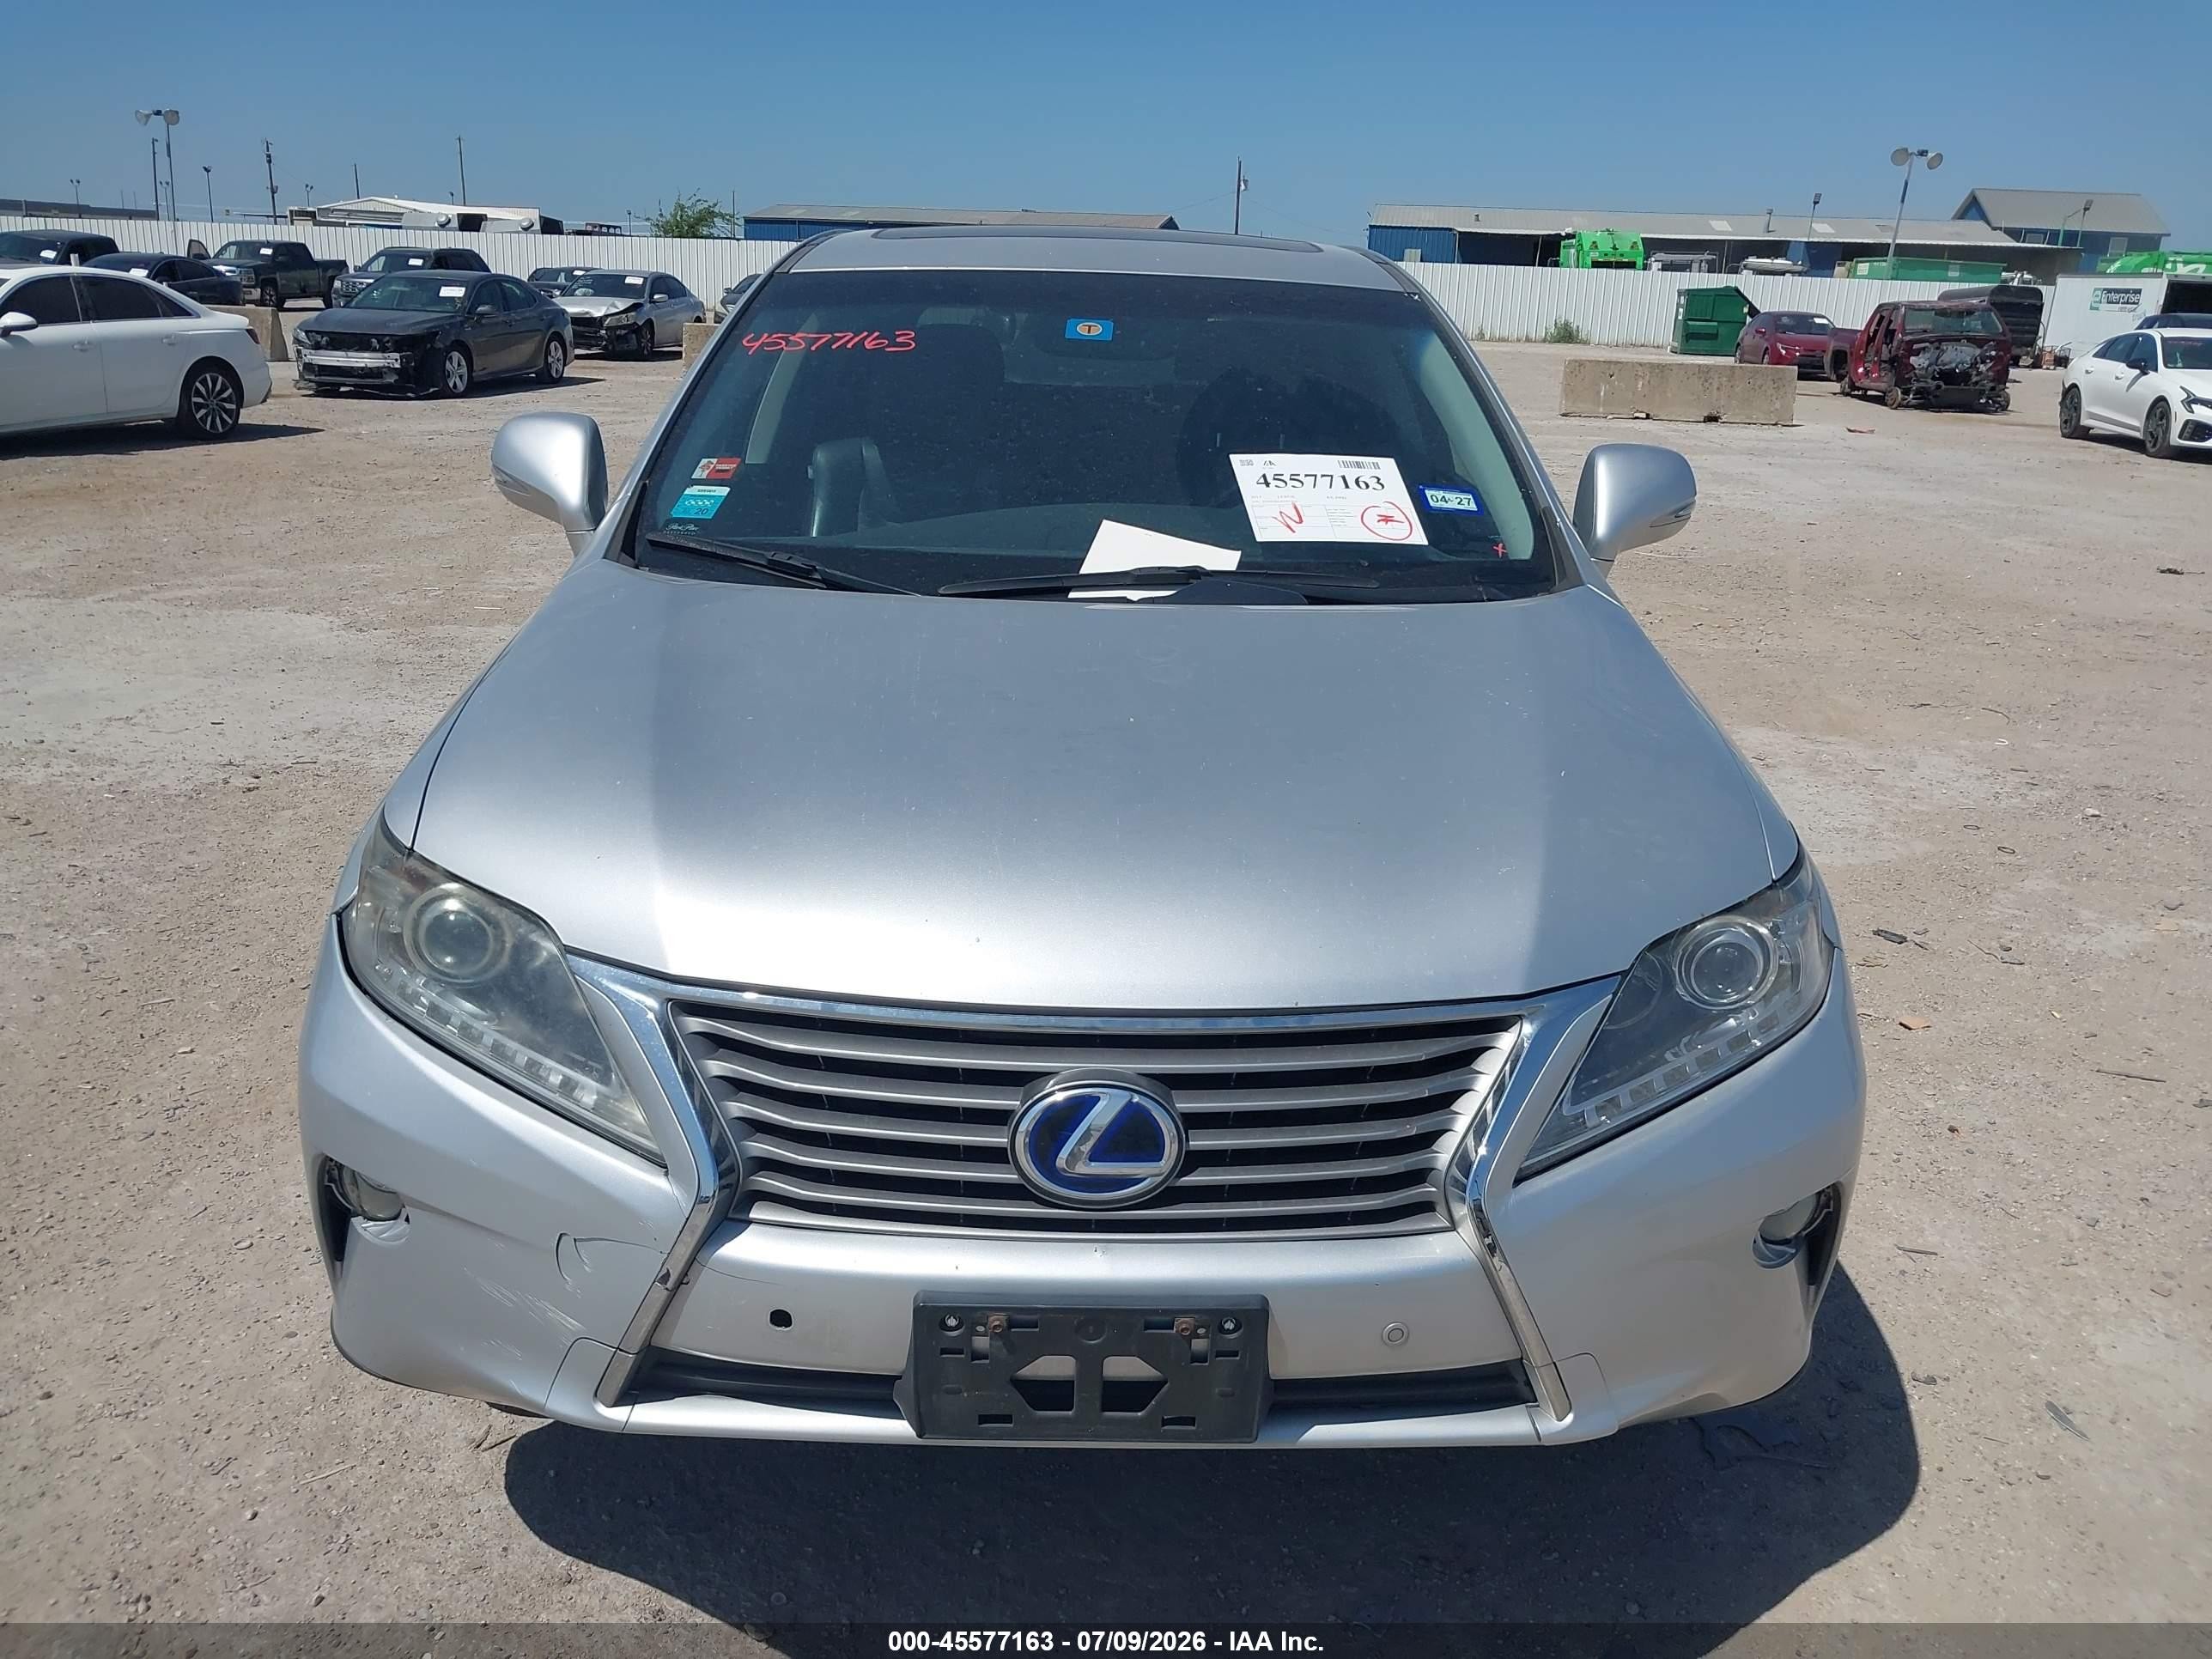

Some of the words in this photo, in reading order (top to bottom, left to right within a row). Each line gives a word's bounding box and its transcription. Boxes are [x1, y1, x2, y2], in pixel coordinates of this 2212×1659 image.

[2101, 290, 2141, 305] Enterprise
[742, 330, 916, 356] 45577163
[1256, 473, 1385, 490] 45577163
